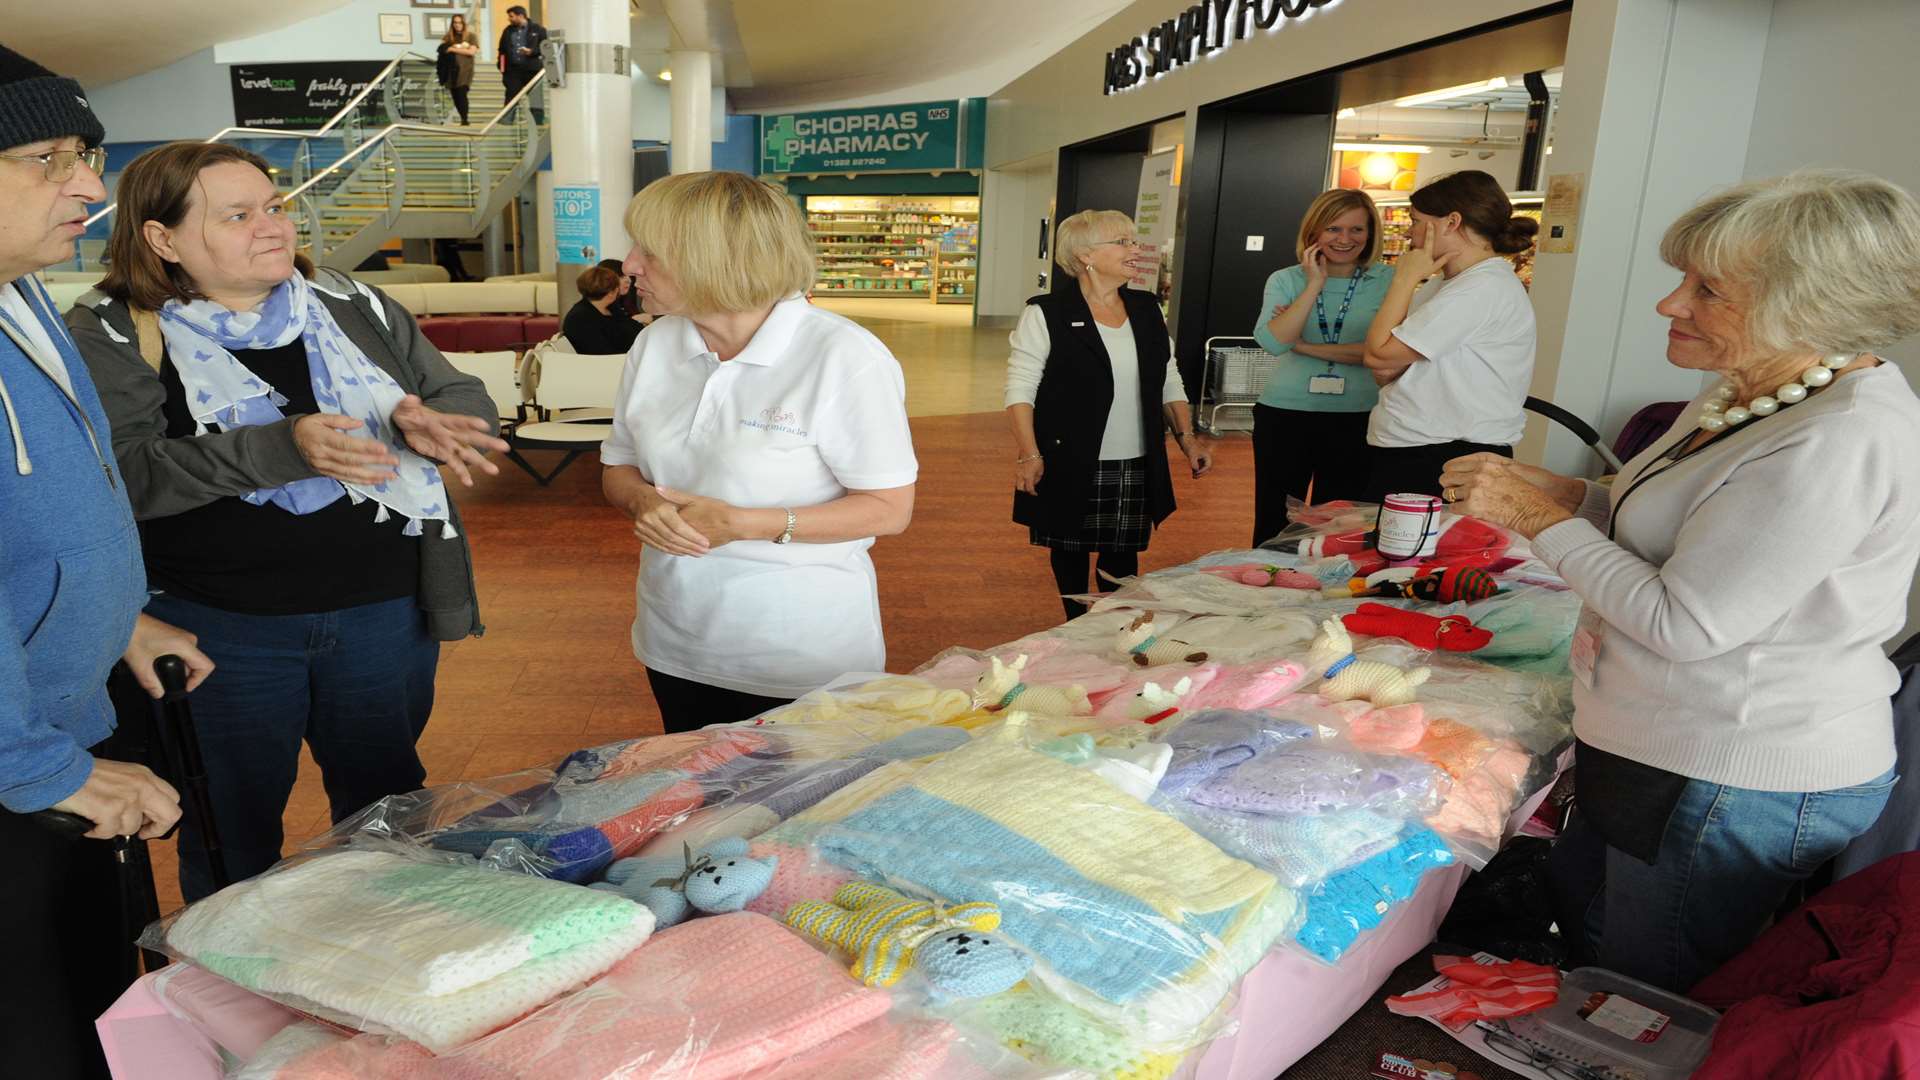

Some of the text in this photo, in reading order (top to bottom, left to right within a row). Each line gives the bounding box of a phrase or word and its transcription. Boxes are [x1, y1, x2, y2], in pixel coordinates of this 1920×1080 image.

[306, 78, 347, 97] freshly
[244, 118, 264, 126] great
[929, 109, 949, 119] NHS
[795, 112, 918, 135] CHOPRAS
[785, 132, 929, 155] PHARMACY
[1381, 1063, 1417, 1077] CLUB
